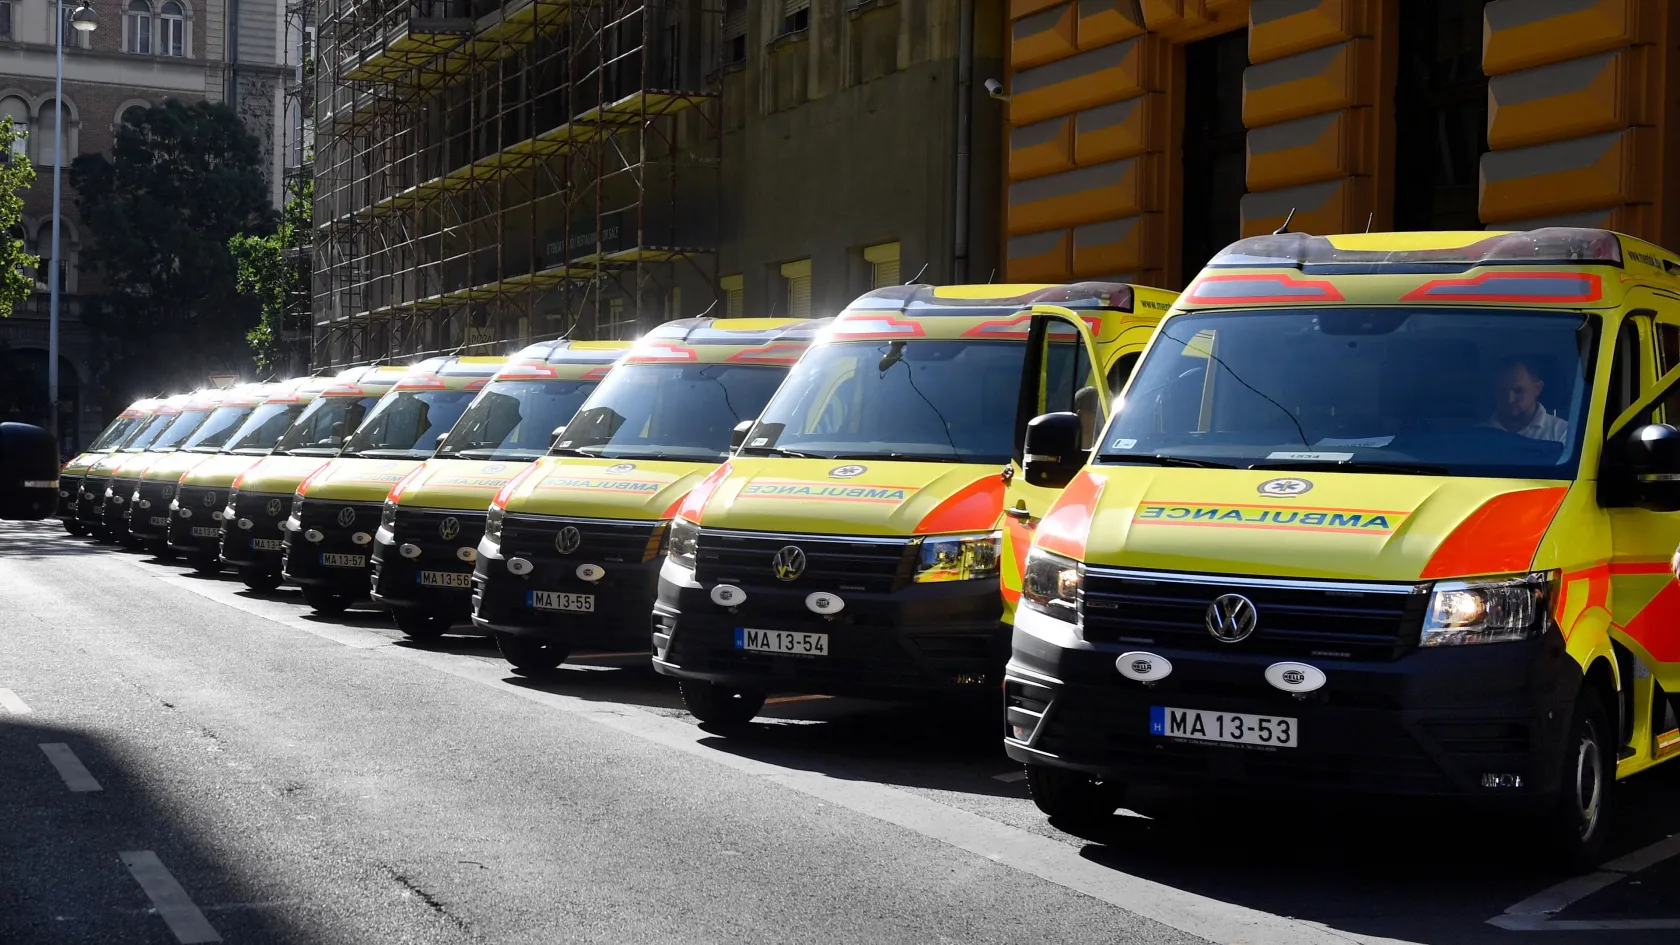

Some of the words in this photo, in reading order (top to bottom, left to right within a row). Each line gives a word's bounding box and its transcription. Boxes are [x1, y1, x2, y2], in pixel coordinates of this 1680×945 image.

[254, 539, 265, 548] MA
[324, 554, 337, 565] MA
[339, 555, 363, 566] 13-57
[423, 572, 438, 584] MA
[440, 573, 470, 587] 13-56
[535, 592, 552, 607] MA
[556, 593, 592, 610] 13-55
[1205, 593, 1257, 643] VW
[747, 630, 771, 650] MA
[776, 632, 824, 653] 13-54
[1153, 722, 1162, 732] H
[1169, 710, 1207, 737] MA
[1216, 714, 1291, 744] 13-53
